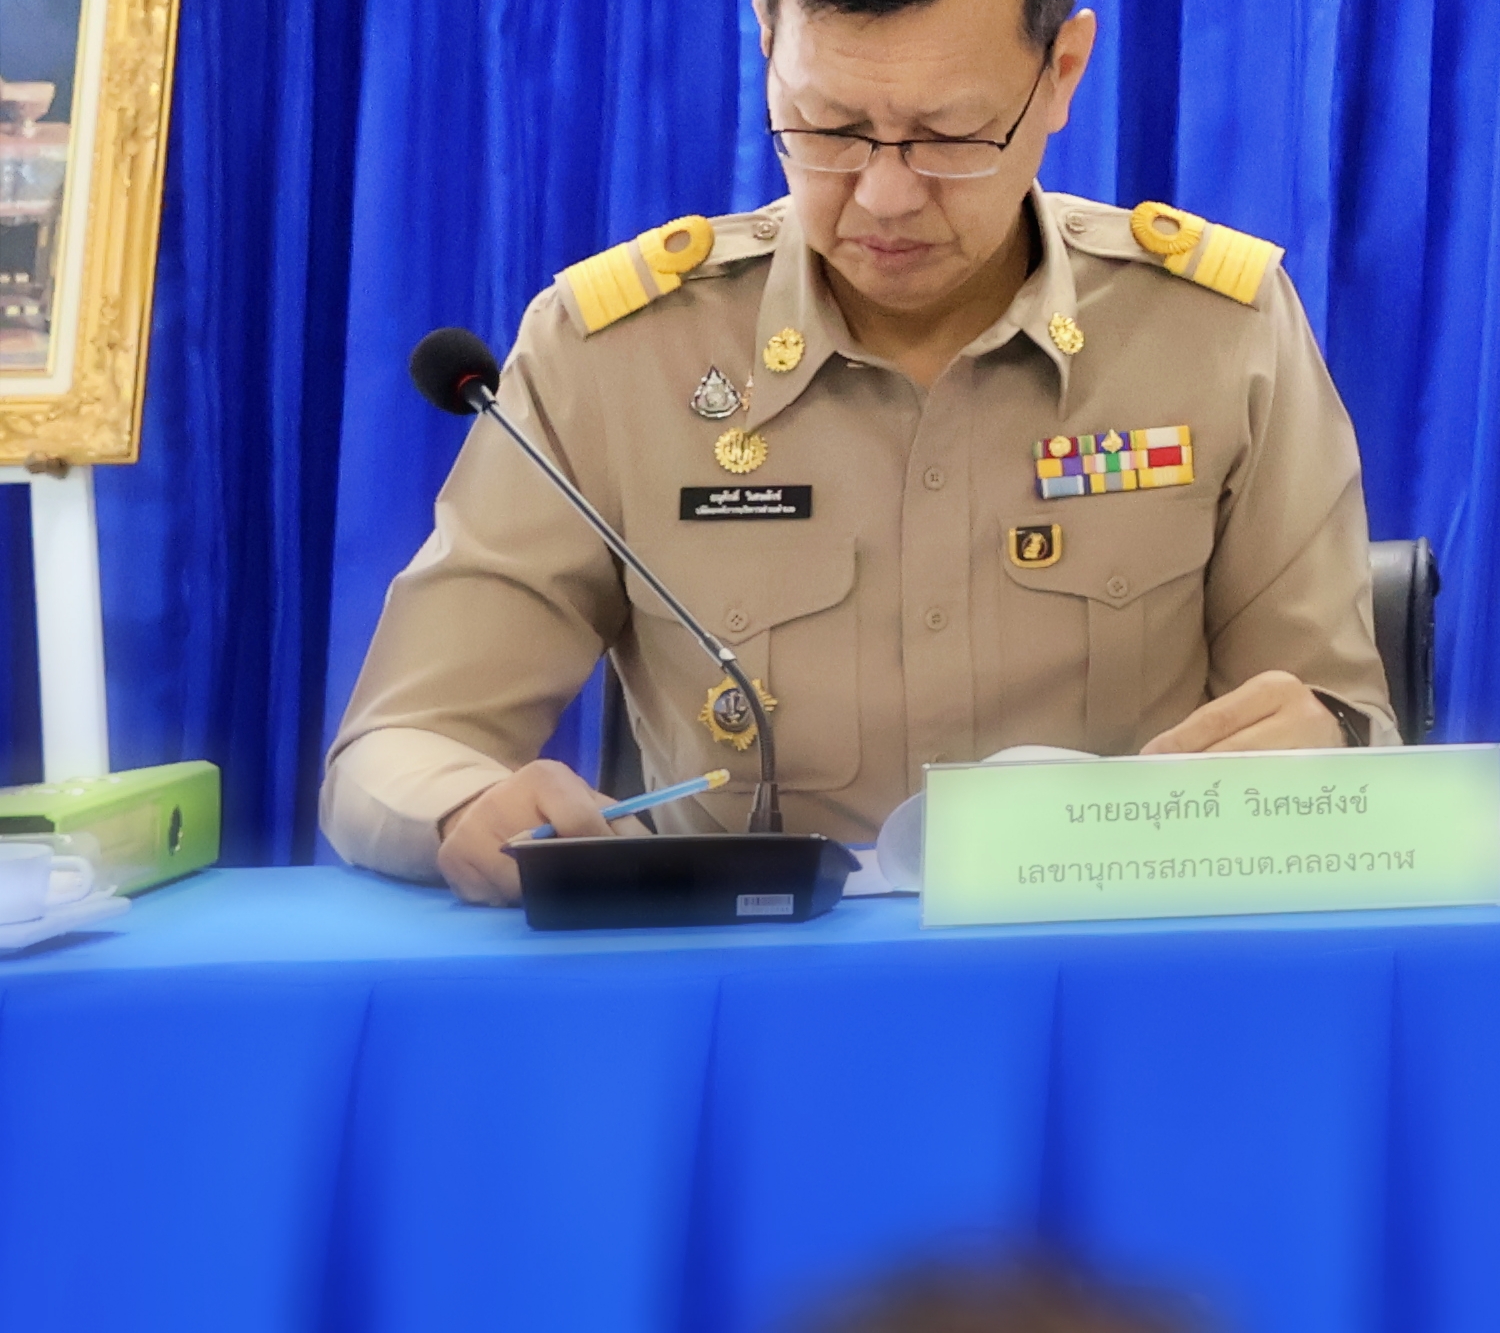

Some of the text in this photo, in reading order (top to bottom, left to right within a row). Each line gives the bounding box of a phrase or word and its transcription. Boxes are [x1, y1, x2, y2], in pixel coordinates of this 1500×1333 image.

[1064, 779, 1370, 831] นายอนุศักดิ์ วิเศษสังข์
[1016, 847, 1417, 892] เลขานุการสภาอบต.คลองวาฬ
